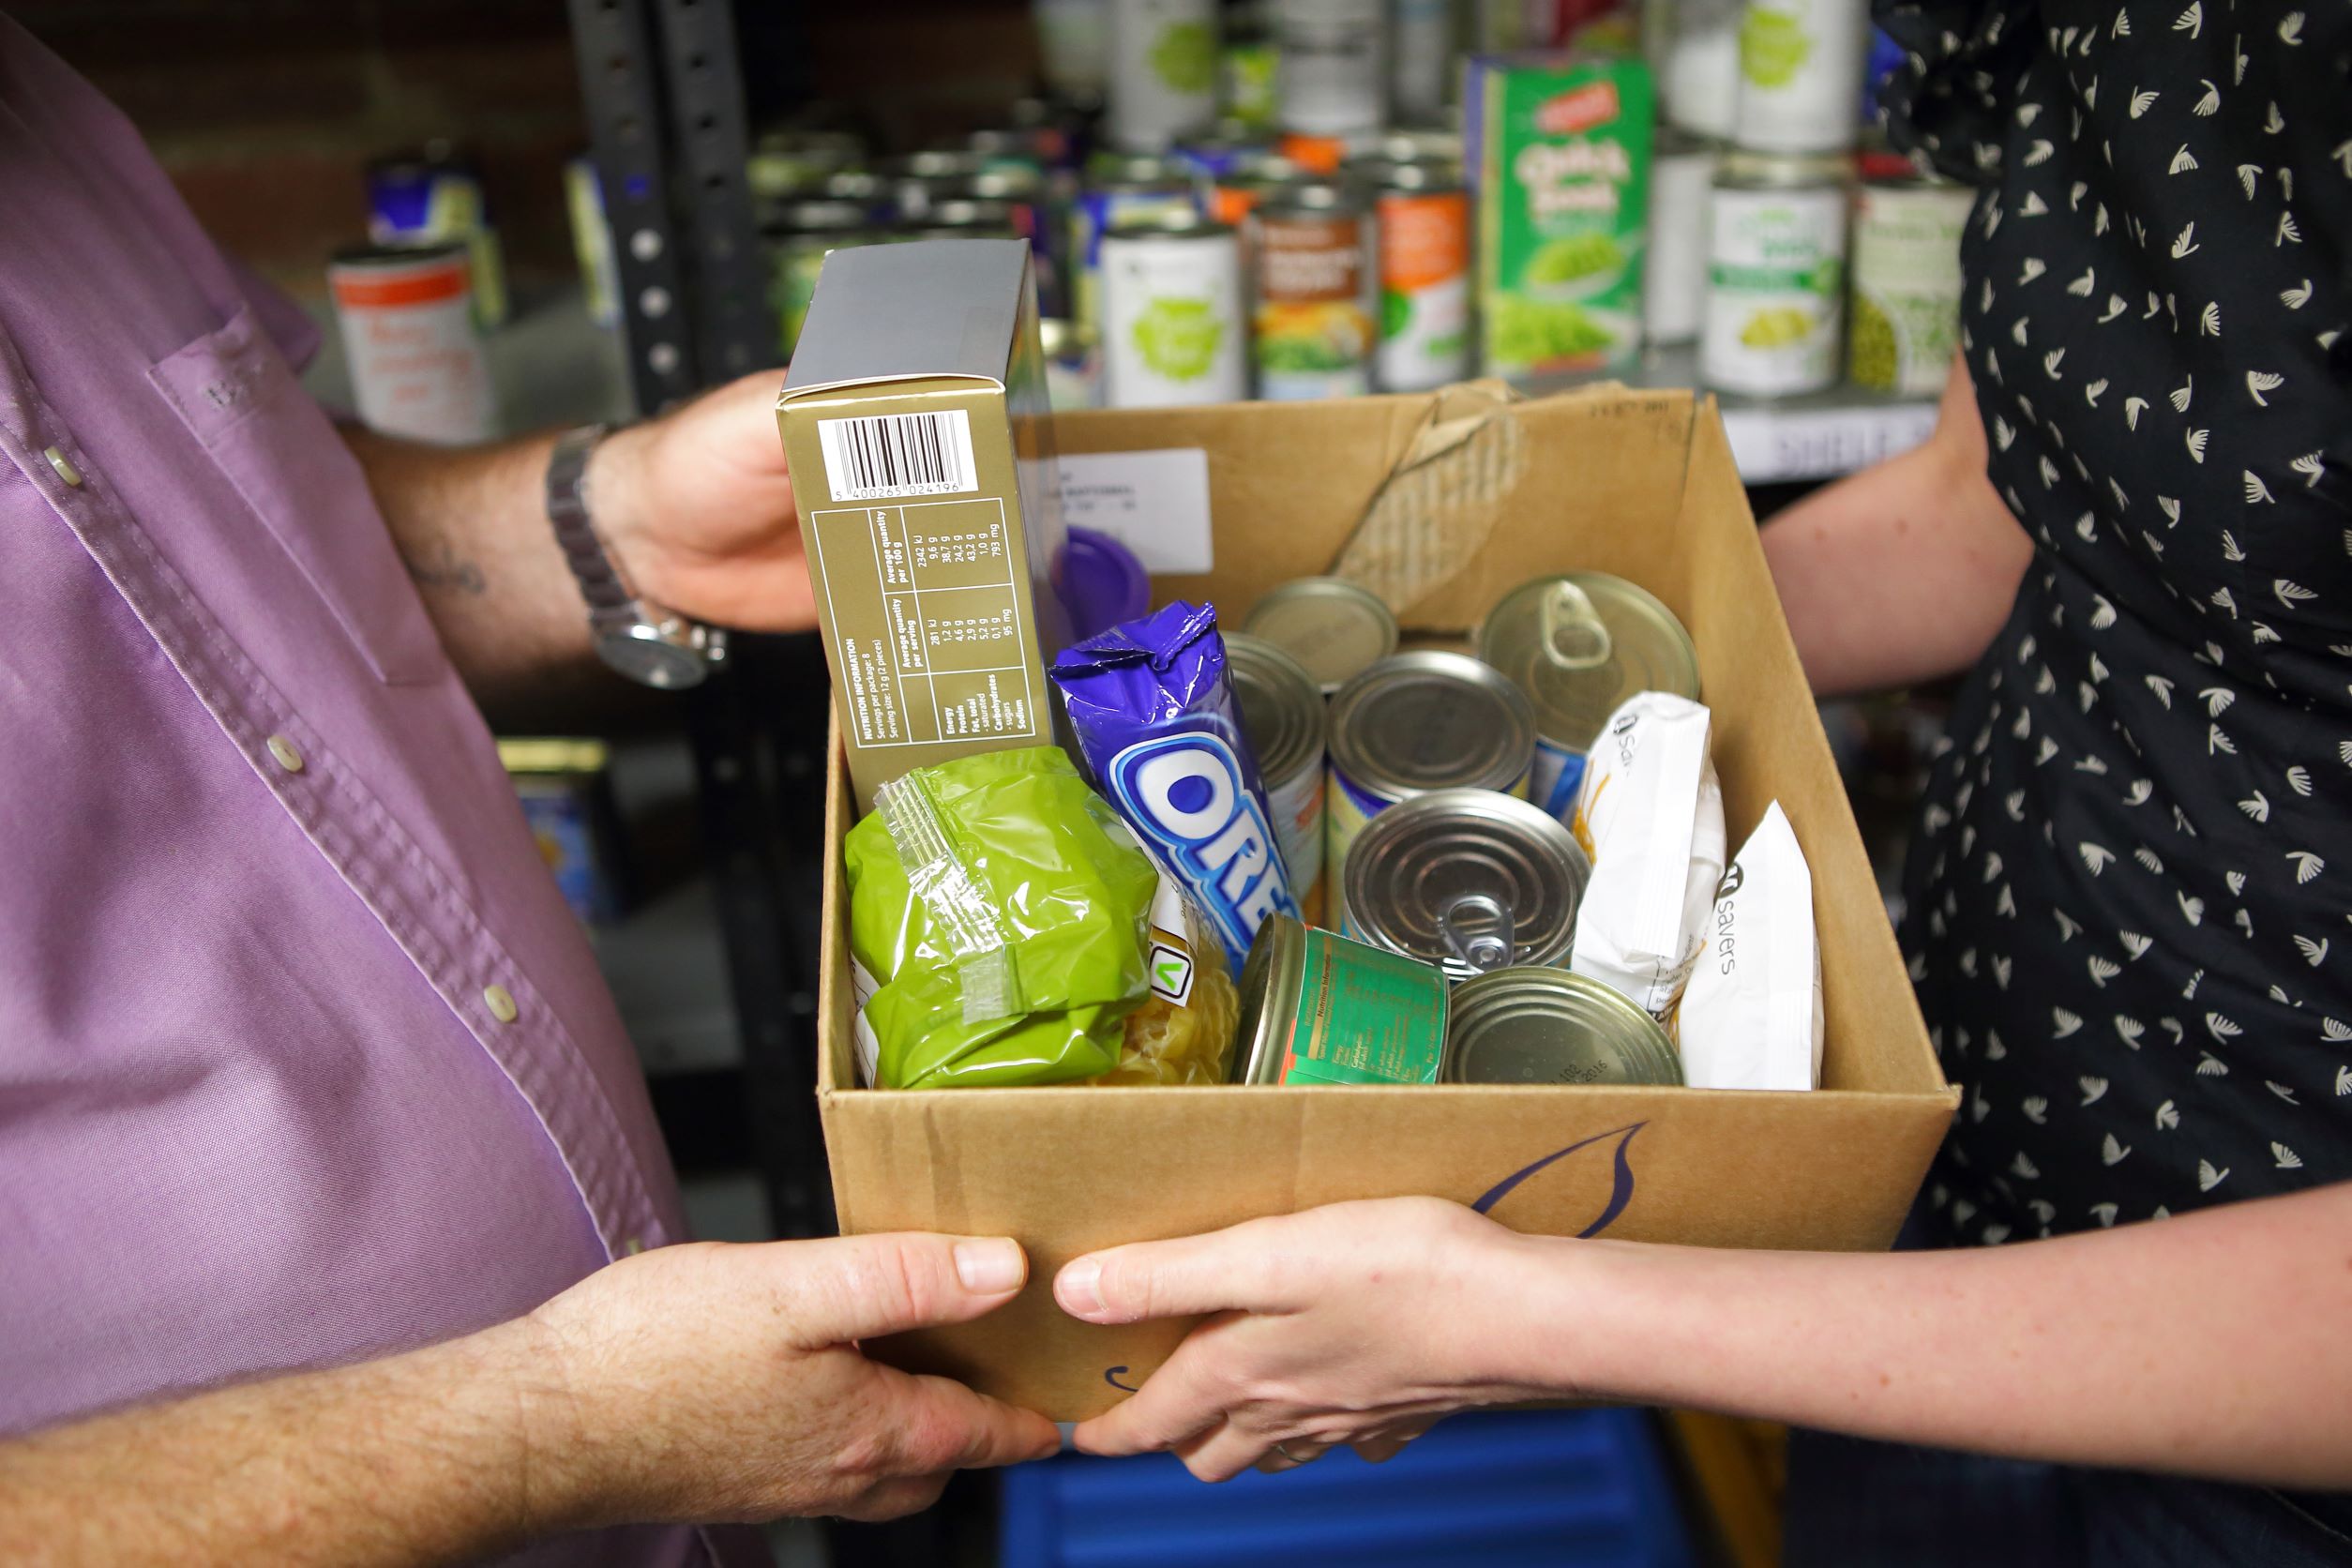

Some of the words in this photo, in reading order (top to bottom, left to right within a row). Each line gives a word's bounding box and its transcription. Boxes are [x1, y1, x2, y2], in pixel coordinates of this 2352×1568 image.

[837, 490, 842, 500] 5
[853, 487, 901, 498] 400265
[910, 483, 959, 495] 024196
[876, 510, 891, 547] quantity
[989, 523, 1000, 537] mg
[913, 535, 924, 544] kJ
[990, 541, 1002, 556] 793
[894, 549, 904, 565] 100
[915, 547, 927, 567] 2342
[928, 547, 939, 559] 9,6
[942, 546, 952, 563] 38,7
[954, 545, 965, 563] 24,2
[966, 544, 976, 562] 43,2
[978, 543, 989, 555] 1,0
[883, 549, 896, 583] Average
[897, 569, 909, 582] per
[892, 598, 907, 634] quantity
[927, 619, 937, 627] kJ
[1002, 609, 1012, 622] mg
[906, 620, 920, 650] serving
[930, 631, 940, 645] 281
[942, 630, 952, 641] 1,2
[954, 629, 965, 641] 4,6
[966, 628, 977, 641] 2,9
[979, 627, 989, 640] 5,2
[990, 627, 1002, 639] 0,1
[1003, 626, 1014, 636] 95
[872, 640, 885, 666] pieces)
[899, 635, 912, 668] Average
[912, 654, 924, 667] per
[846, 639, 865, 695] INFORMATION
[865, 659, 879, 693] package:
[880, 683, 890, 691] 12
[868, 694, 880, 706] per
[882, 693, 894, 710] size:
[967, 699, 978, 717] total
[988, 674, 1003, 731] Carbohydrates
[857, 697, 873, 740] NUTRITION
[956, 704, 968, 733] Protein
[977, 693, 990, 728] saturated
[1003, 701, 1015, 726] sugars
[1015, 700, 1026, 730] Sodium
[871, 708, 885, 739] Servings
[885, 710, 899, 738] Serving
[943, 707, 956, 735] Energy
[971, 718, 981, 732] Fat,
[1136, 749, 1288, 935] ORE
[1718, 900, 1735, 975] savers
[1582, 1059, 1607, 1081] 2016
